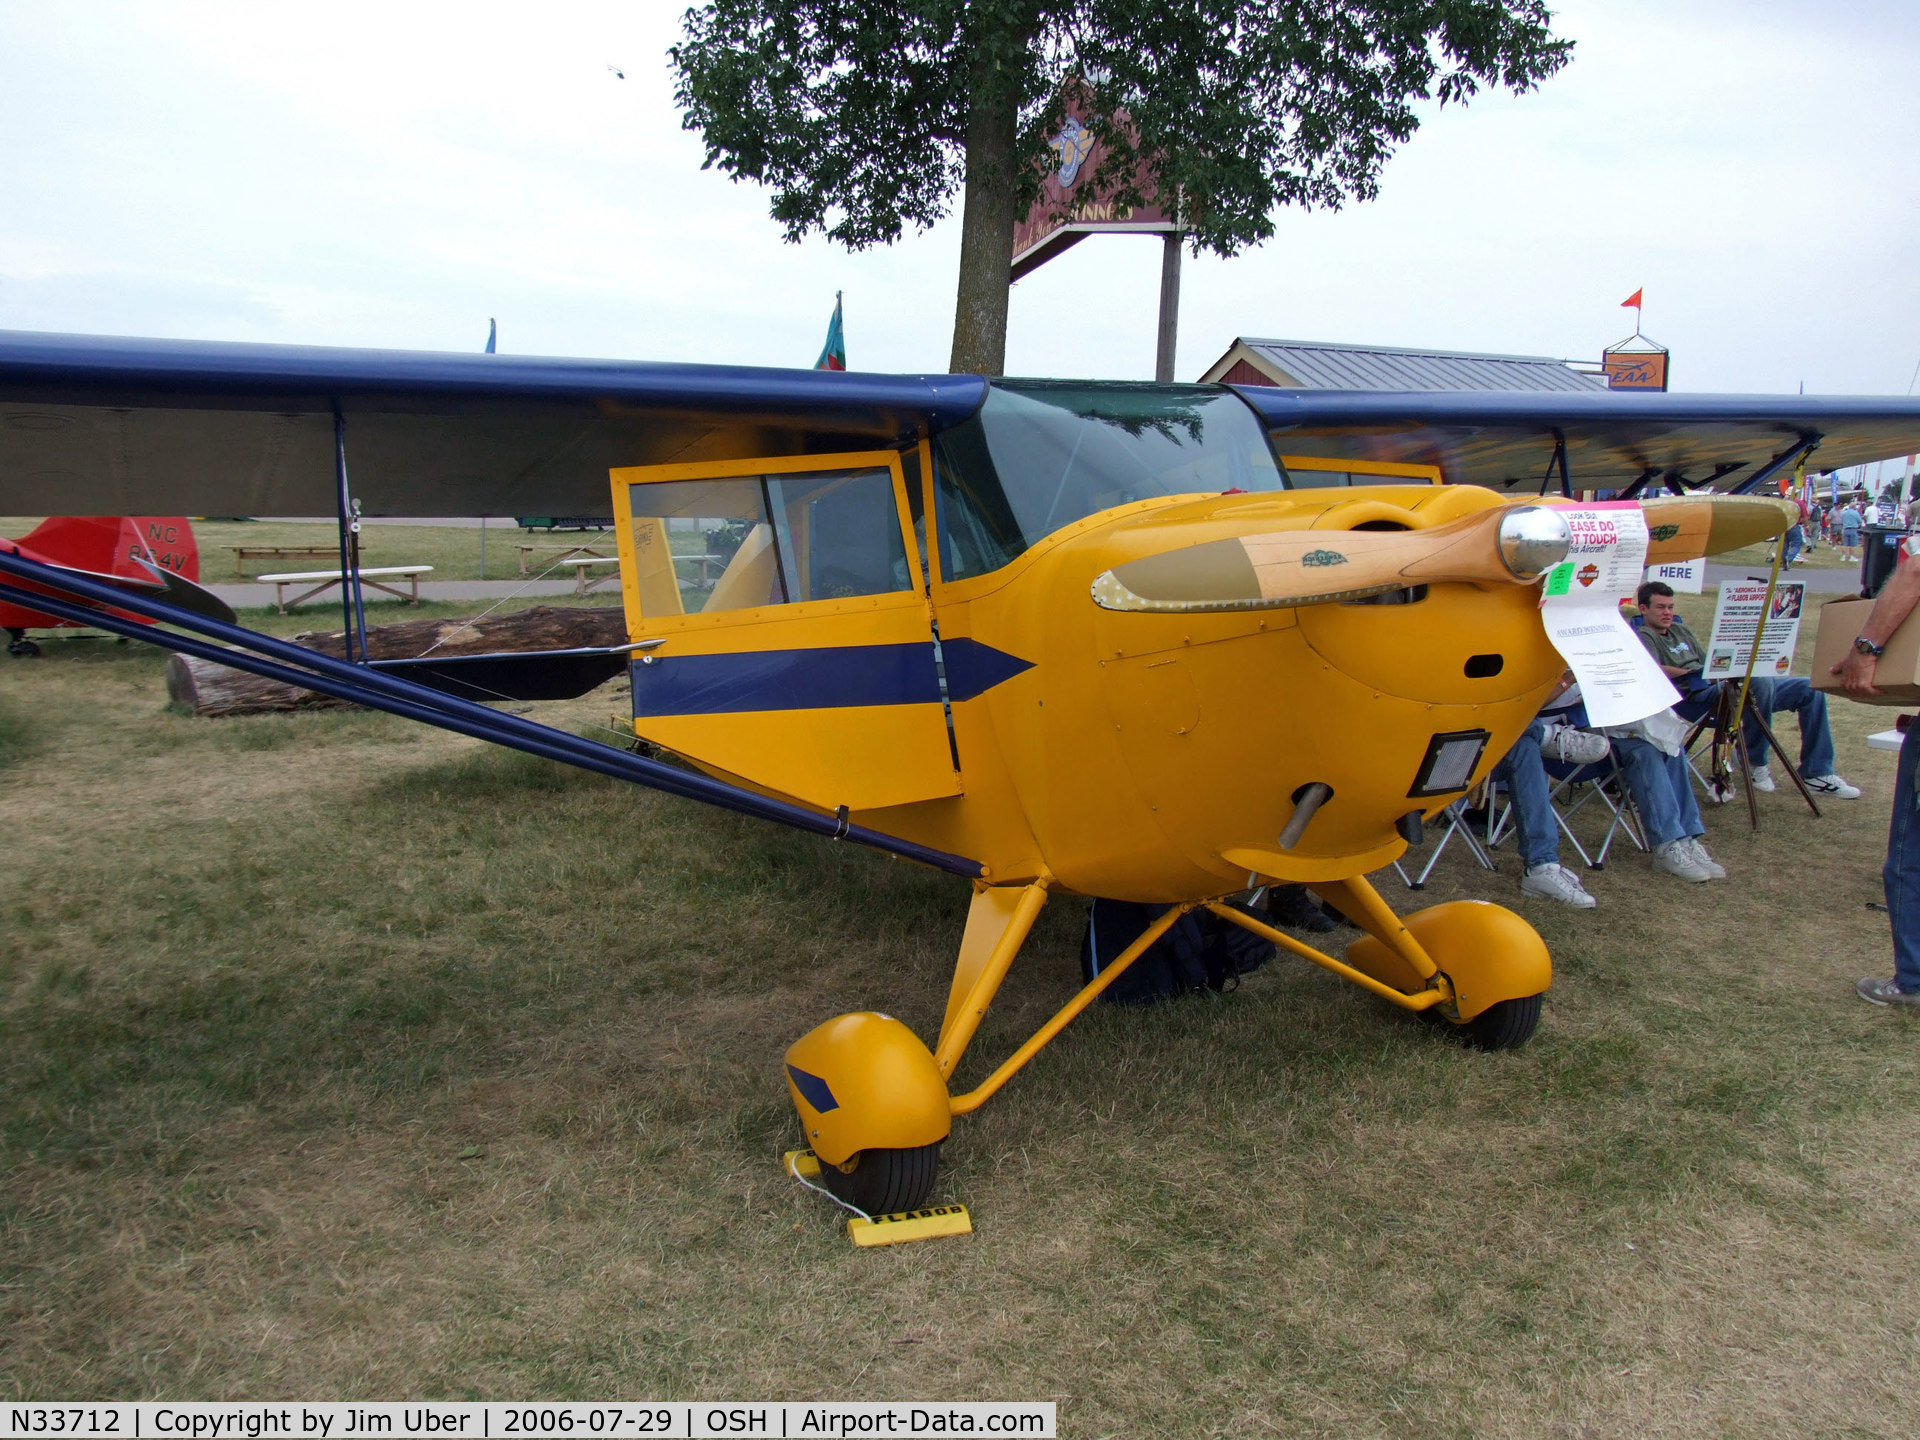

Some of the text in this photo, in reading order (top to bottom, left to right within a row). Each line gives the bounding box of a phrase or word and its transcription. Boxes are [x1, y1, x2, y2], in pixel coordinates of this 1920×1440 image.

[1612, 371, 1648, 383] EAA
[1569, 521, 1615, 532] EASE DO
[149, 523, 177, 544] NC
[1582, 533, 1617, 545] TOUCH
[1569, 545, 1580, 553] his
[1660, 566, 1692, 579] HERE
[871, 1205, 963, 1225] FLABOB
